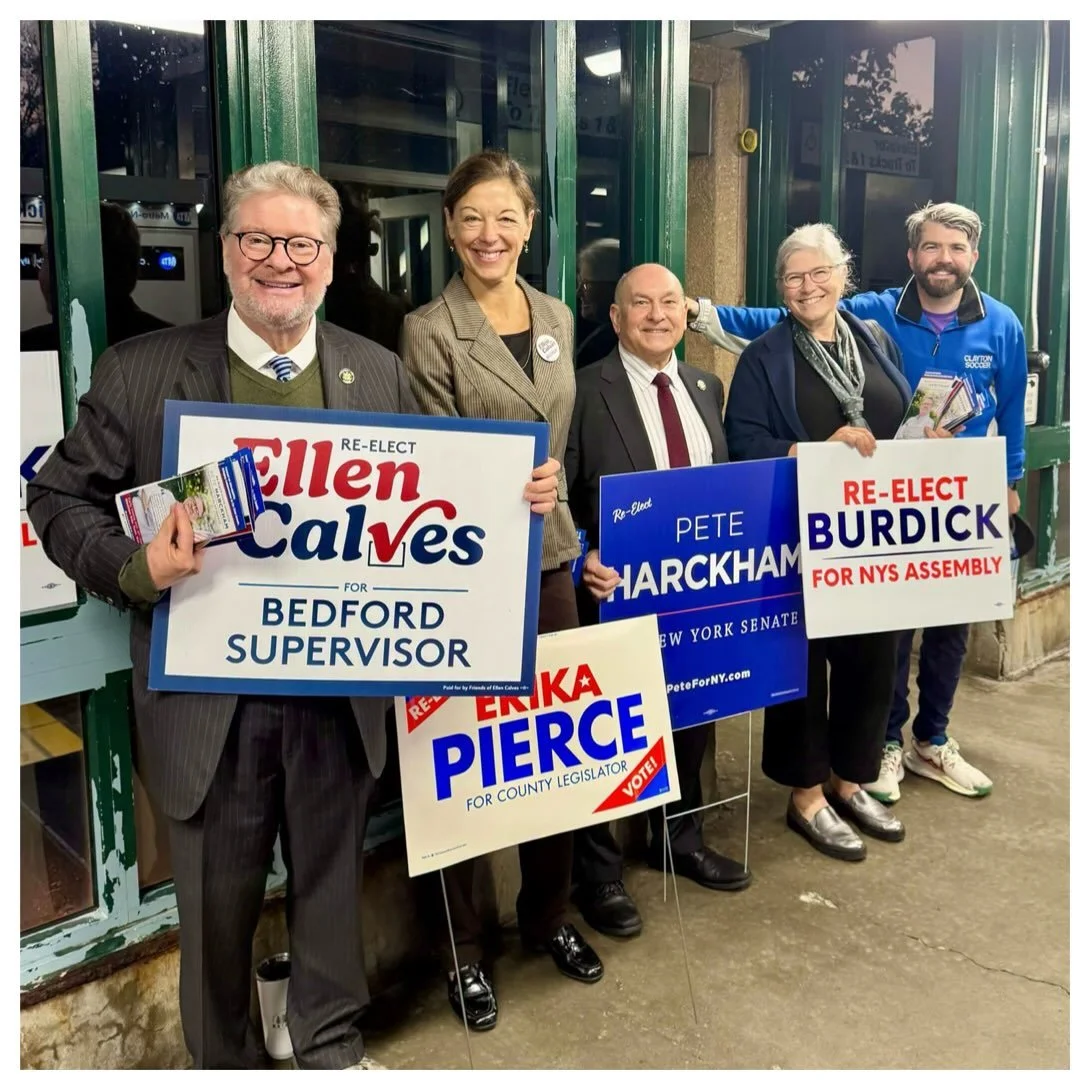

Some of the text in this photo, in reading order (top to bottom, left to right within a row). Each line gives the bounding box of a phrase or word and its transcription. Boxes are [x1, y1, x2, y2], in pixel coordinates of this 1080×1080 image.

[963, 354, 993, 362] CLAYTON
[964, 361, 992, 369] SOCCER
[341, 438, 416, 454] RE-ELECT
[233, 437, 420, 501] Ellen
[843, 476, 968, 507] RE-ELECT
[613, 498, 652, 523] Re-Elect
[676, 511, 744, 543] PETE
[807, 503, 1001, 550] BURDICK
[237, 500, 486, 567] Calves
[344, 582, 369, 593] FOR
[606, 544, 801, 604] HARCKHAM
[812, 556, 1002, 588] FOR NYS ASSEMBLY
[262, 598, 444, 629] BEDFORD
[658, 611, 799, 648] EW YORK SENATE
[225, 633, 471, 669] SUPERVISOR
[475, 663, 603, 721] ERIKA
[667, 669, 751, 694] PeteForNY.com
[432, 693, 649, 800] PIERCE
[466, 760, 629, 812] FOR COUNTY LEGISLATOR
[622, 756, 657, 798] VOTE!
